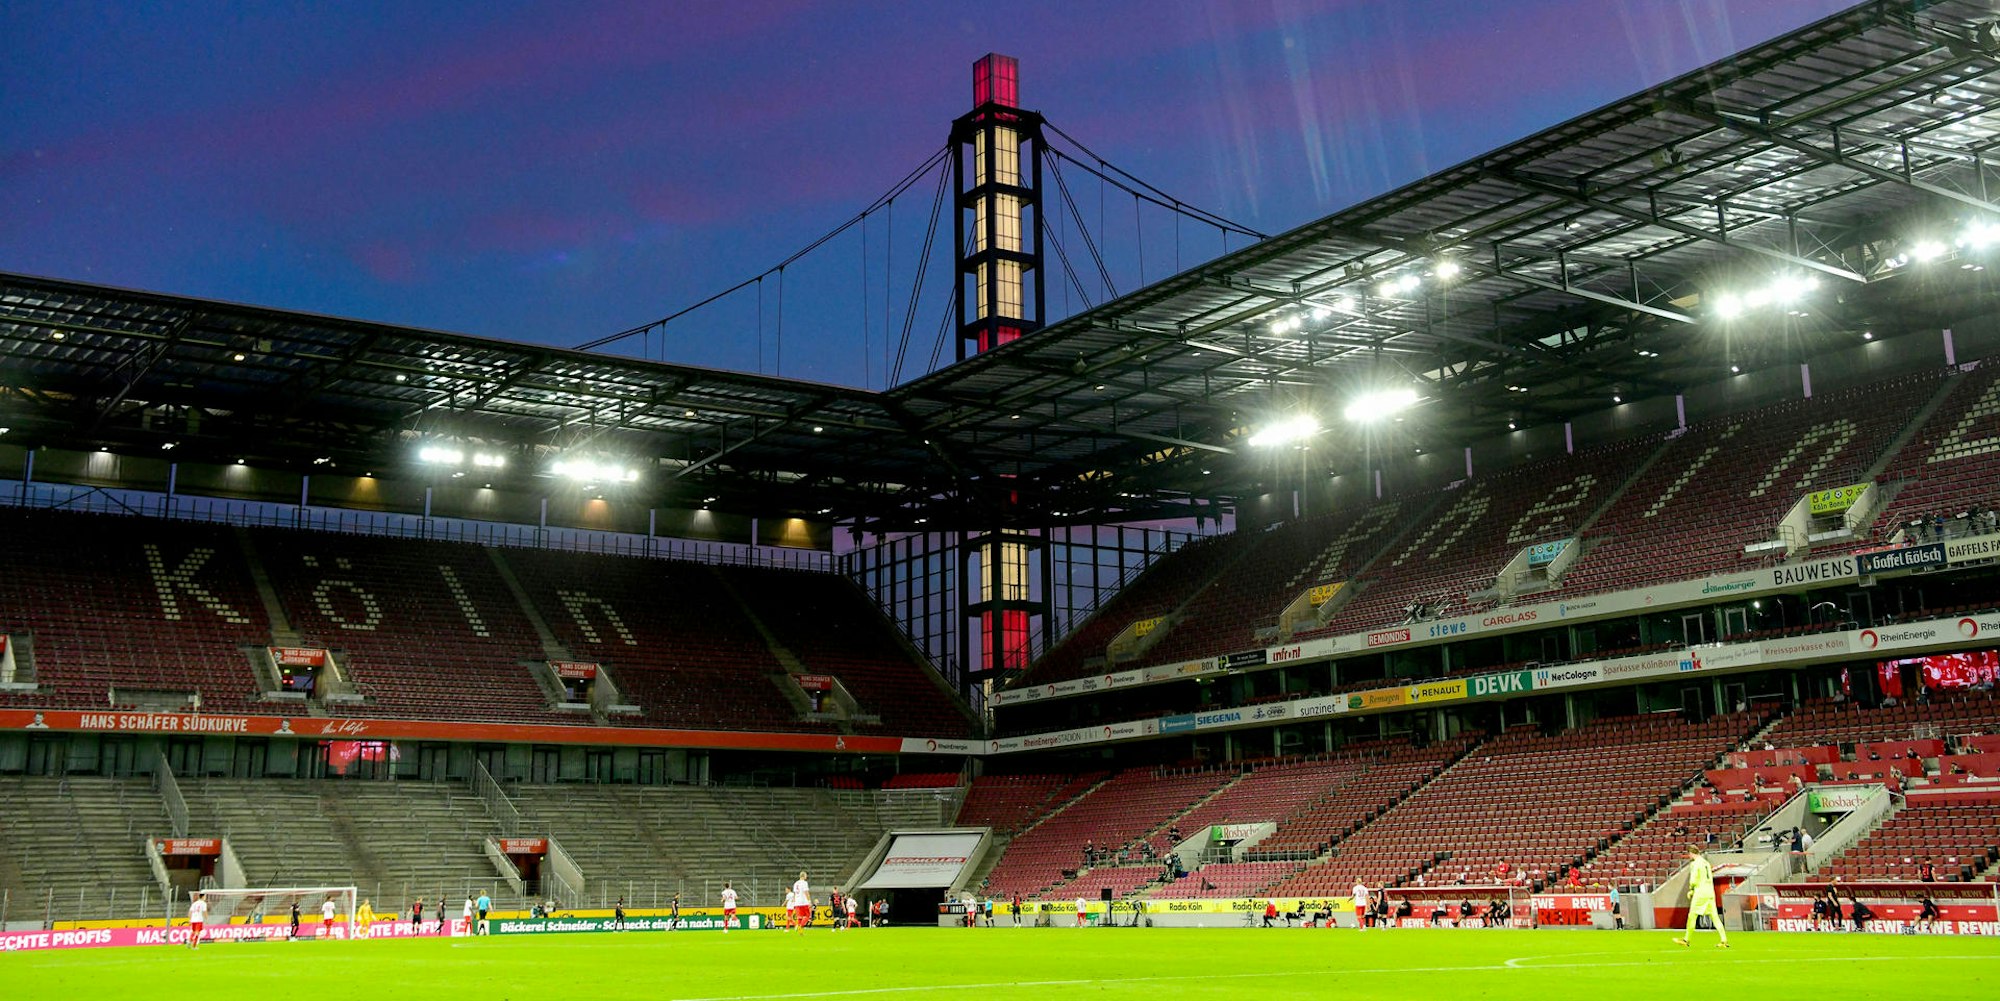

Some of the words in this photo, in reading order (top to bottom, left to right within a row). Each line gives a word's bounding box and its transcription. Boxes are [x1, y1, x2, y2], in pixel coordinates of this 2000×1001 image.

[1948, 541, 1989, 558] GAFFELS
[1873, 552, 1903, 570] Gaffel
[1905, 546, 1942, 565] Kölsch
[1773, 558, 1853, 586] BAUWENS
[1702, 578, 1756, 595] dillenburger
[1482, 610, 1538, 628] CARGLASS
[1430, 620, 1467, 637] stewe
[1880, 628, 1936, 643] RheinEnergie
[1764, 642, 1824, 656] Kreissparkasse
[1825, 638, 1844, 649] Köln
[1603, 663, 1640, 676] Sparkasse
[1641, 658, 1679, 670] KölnBonn
[1551, 669, 1597, 682] NetCologne
[1422, 684, 1461, 698] RENAULT
[1475, 673, 1524, 696] DEVK
[1300, 702, 1336, 718] sunzinet
[80, 714, 117, 729] HANS
[119, 713, 178, 731] SCHÄFER
[182, 715, 248, 732] SÜDKURVE
[1197, 711, 1242, 726] SIEGENIA
[1169, 903, 1187, 911] Radio
[1188, 902, 1203, 911] Köln
[1232, 902, 1251, 910] Radio
[1531, 897, 1555, 910] EWE
[1571, 897, 1606, 910] REWE
[500, 921, 546, 933] Bäckerei
[547, 920, 597, 932] Schneider
[652, 918, 689, 931] einfch
[689, 917, 714, 928] nach
[1402, 918, 1425, 928] REWE
[1537, 908, 1593, 926] REWE
[1959, 922, 2000, 936] REWE
[52, 929, 112, 946] PROFIS
